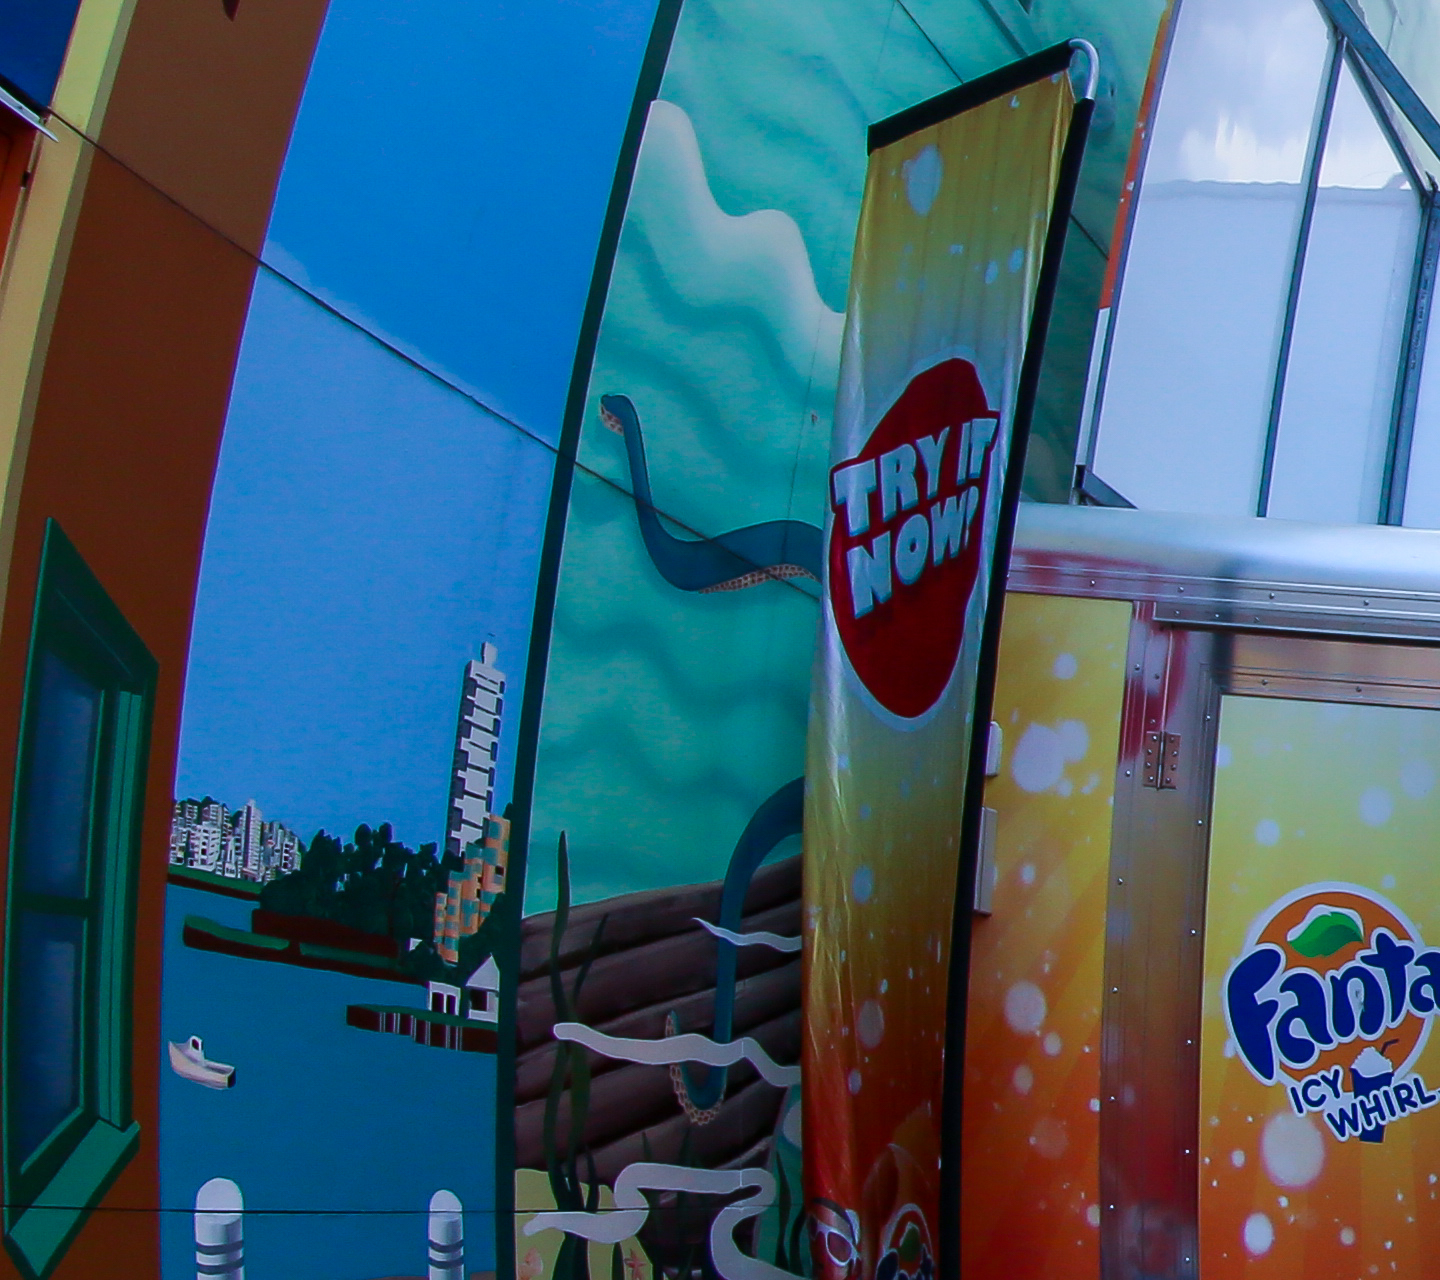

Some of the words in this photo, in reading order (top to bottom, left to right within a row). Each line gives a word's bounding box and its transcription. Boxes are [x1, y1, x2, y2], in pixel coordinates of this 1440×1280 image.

[834, 426, 950, 537] TRY
[956, 418, 998, 485] IT
[846, 485, 980, 619] NOW!
[1290, 1068, 1342, 1114] ICY
